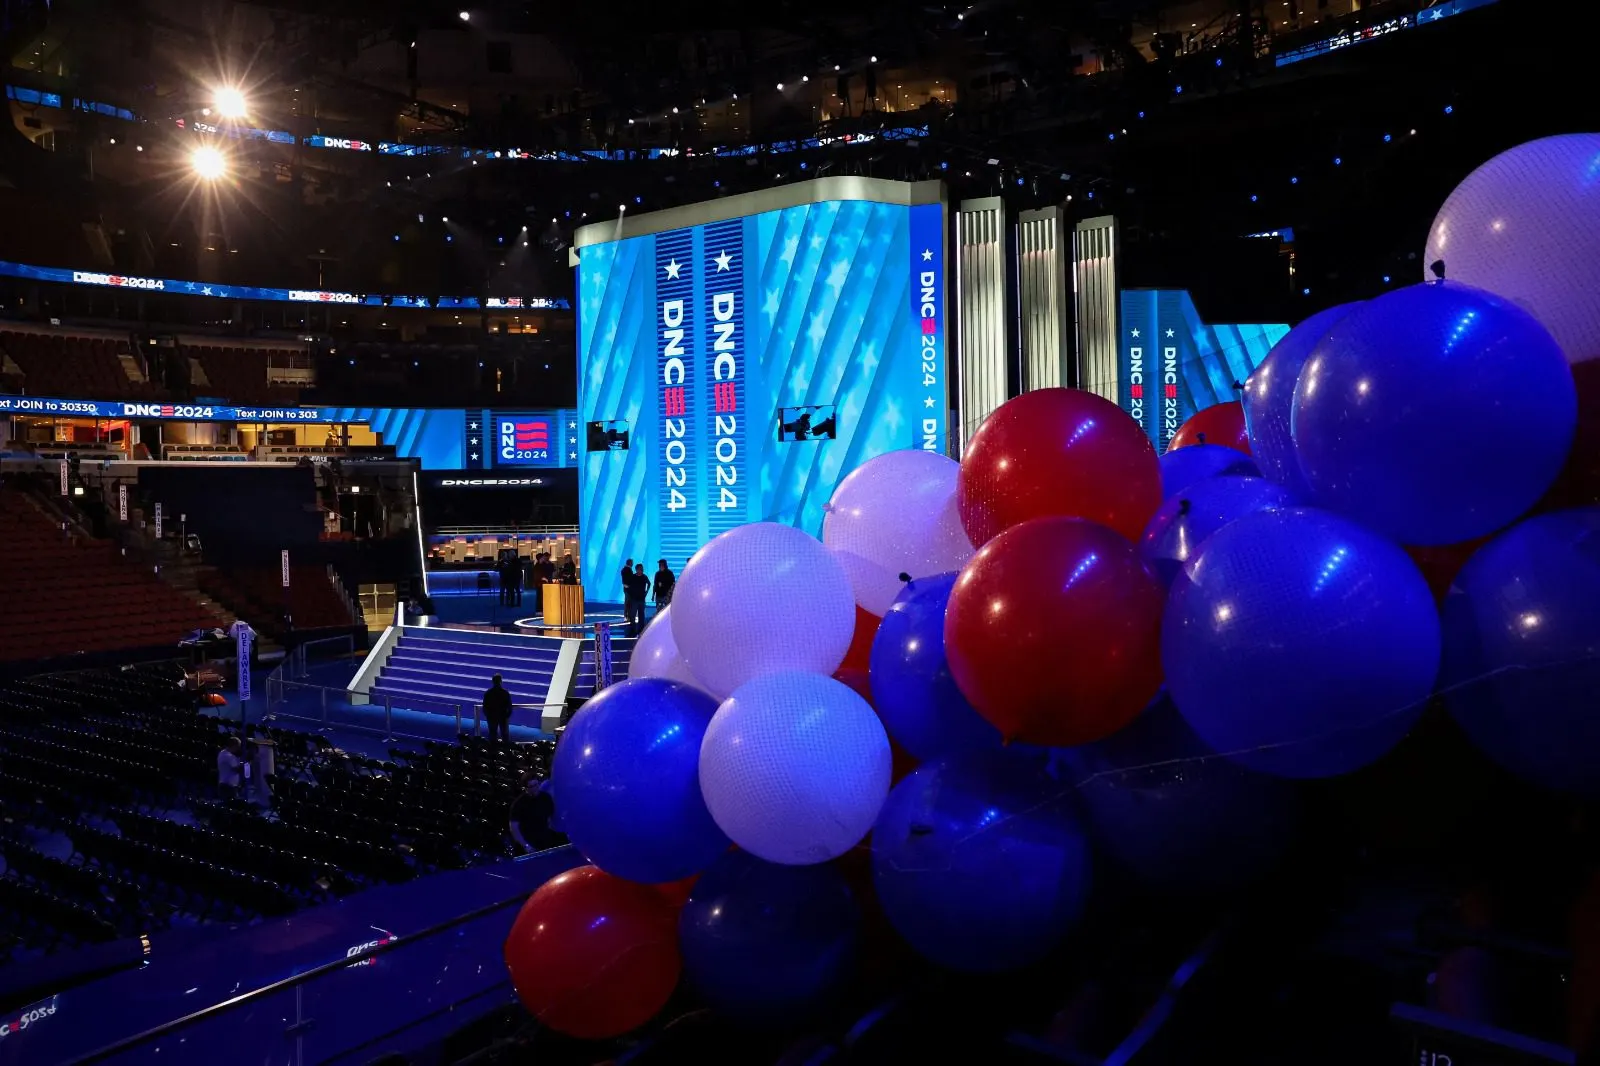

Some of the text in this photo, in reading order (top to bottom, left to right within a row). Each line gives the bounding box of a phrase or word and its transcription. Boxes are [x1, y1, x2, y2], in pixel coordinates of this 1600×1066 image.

[920, 271, 936, 387] DNC 2024
[13, 399, 43, 410] JOIN
[46, 401, 58, 410] to
[60, 402, 96, 412] 30330
[174, 405, 214, 418] 2024
[235, 409, 318, 419] Text JOIN to 303
[663, 299, 687, 512] DNC 2024
[713, 292, 737, 512] DNC 2024
[1131, 398, 1143, 427] 20
[922, 418, 937, 453] DN
[516, 450, 548, 459] 2024
[241, 632, 249, 689] DELAWARE
